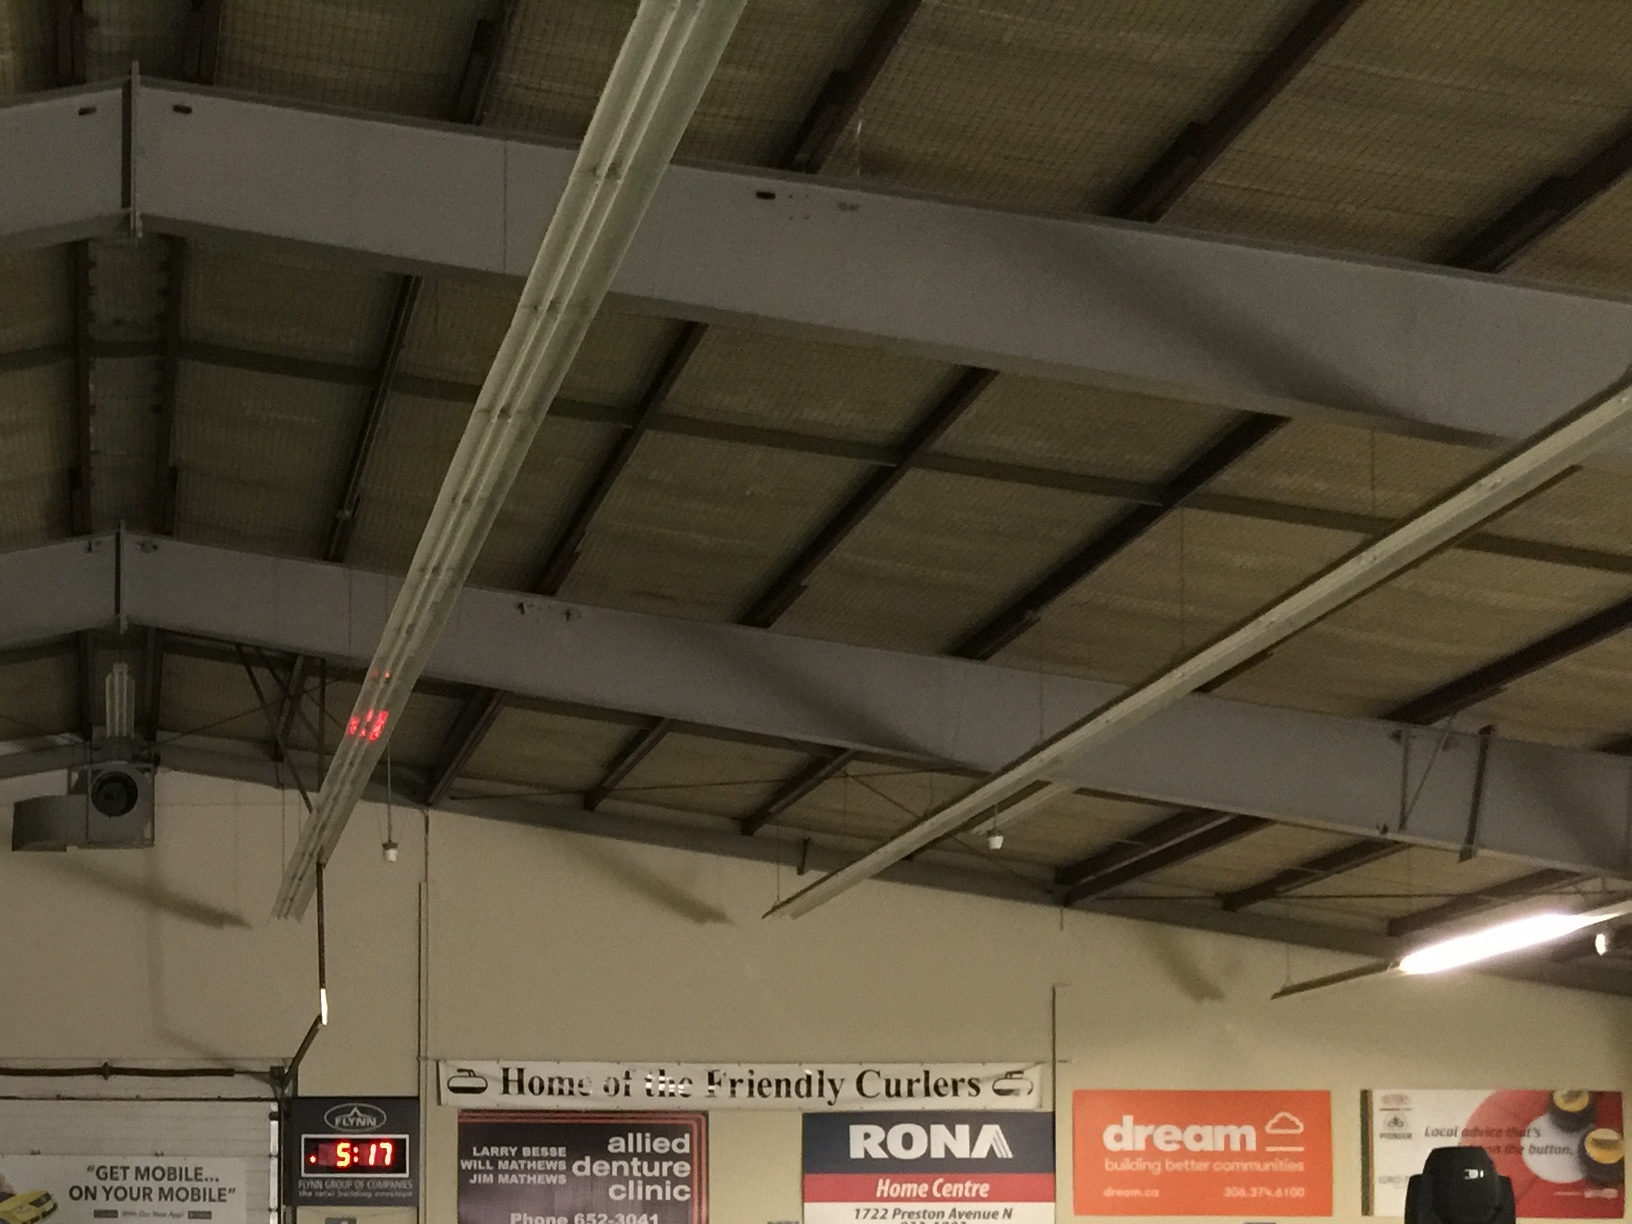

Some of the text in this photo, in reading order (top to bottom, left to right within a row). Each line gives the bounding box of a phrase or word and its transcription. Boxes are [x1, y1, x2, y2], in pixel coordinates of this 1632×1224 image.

[500, 1067, 982, 1106] Home of the Friendly Curlers
[335, 1117, 377, 1127] FLYNN
[1102, 1114, 1257, 1152] dream
[1424, 1126, 1458, 1138] Local
[1460, 1126, 1503, 1138] advice
[607, 1132, 690, 1154] allied
[848, 1123, 1014, 1160] RONA
[336, 1142, 393, 1167] 5:17
[472, 1146, 567, 1157] LARRY BESSE
[460, 1160, 567, 1171] WILL MATHEWS
[571, 1156, 691, 1177] denture
[1104, 1158, 1304, 1175] building better communities
[469, 1173, 567, 1184] JIM MATHEWS
[68, 1187, 101, 1201] ON
[105, 1187, 154, 1201] YOUR
[607, 1180, 691, 1201] clinic
[876, 1178, 989, 1198] Home Centre
[854, 1208, 1013, 1220] 1722 Preston Avenue N
